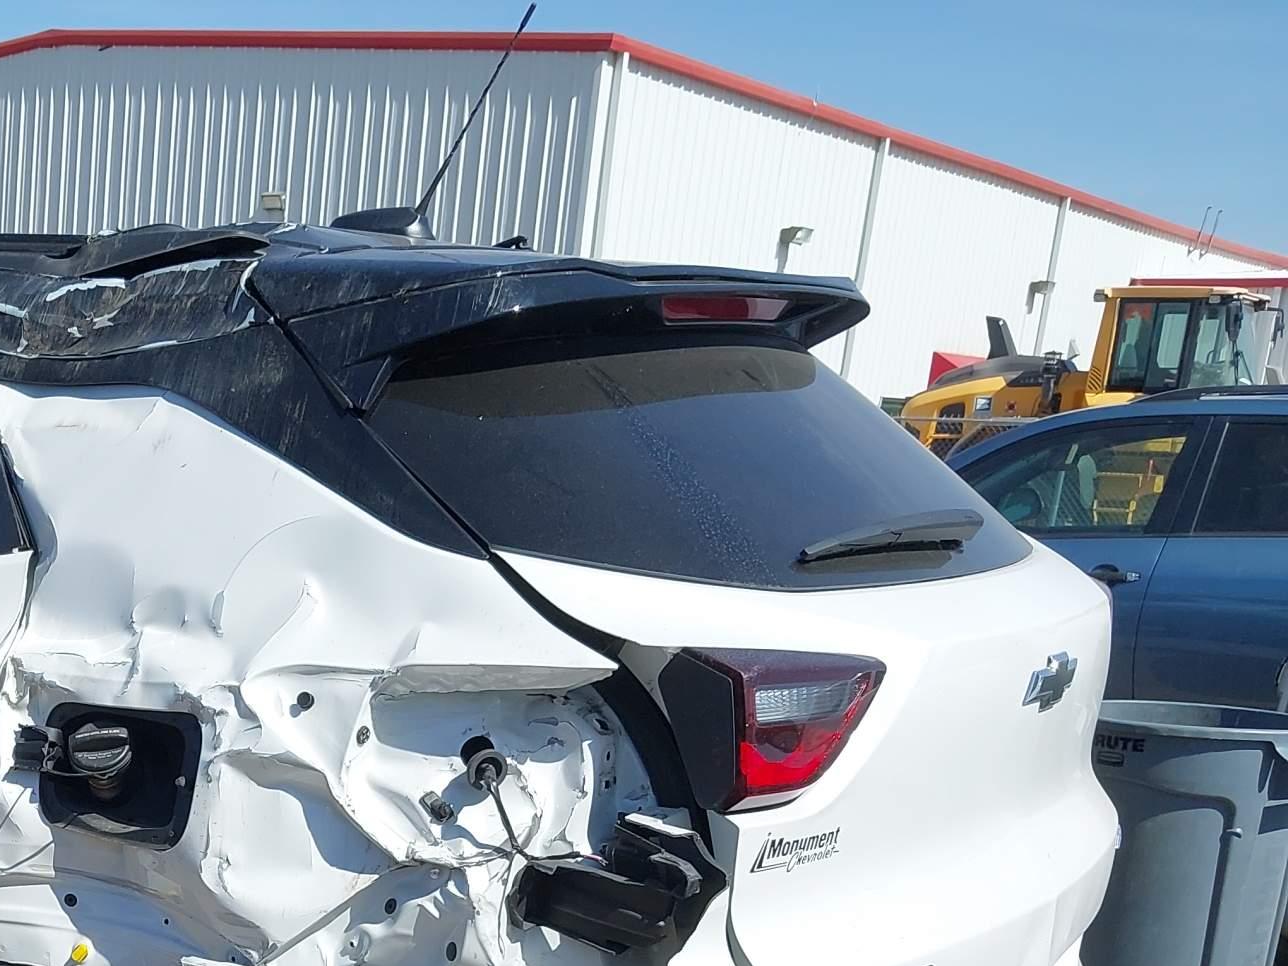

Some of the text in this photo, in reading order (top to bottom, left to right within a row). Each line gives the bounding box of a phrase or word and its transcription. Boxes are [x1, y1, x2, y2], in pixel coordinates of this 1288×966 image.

[1094, 734, 1145, 753] RUTE
[766, 826, 841, 860] Monument
[785, 843, 840, 873] Chevrolet
